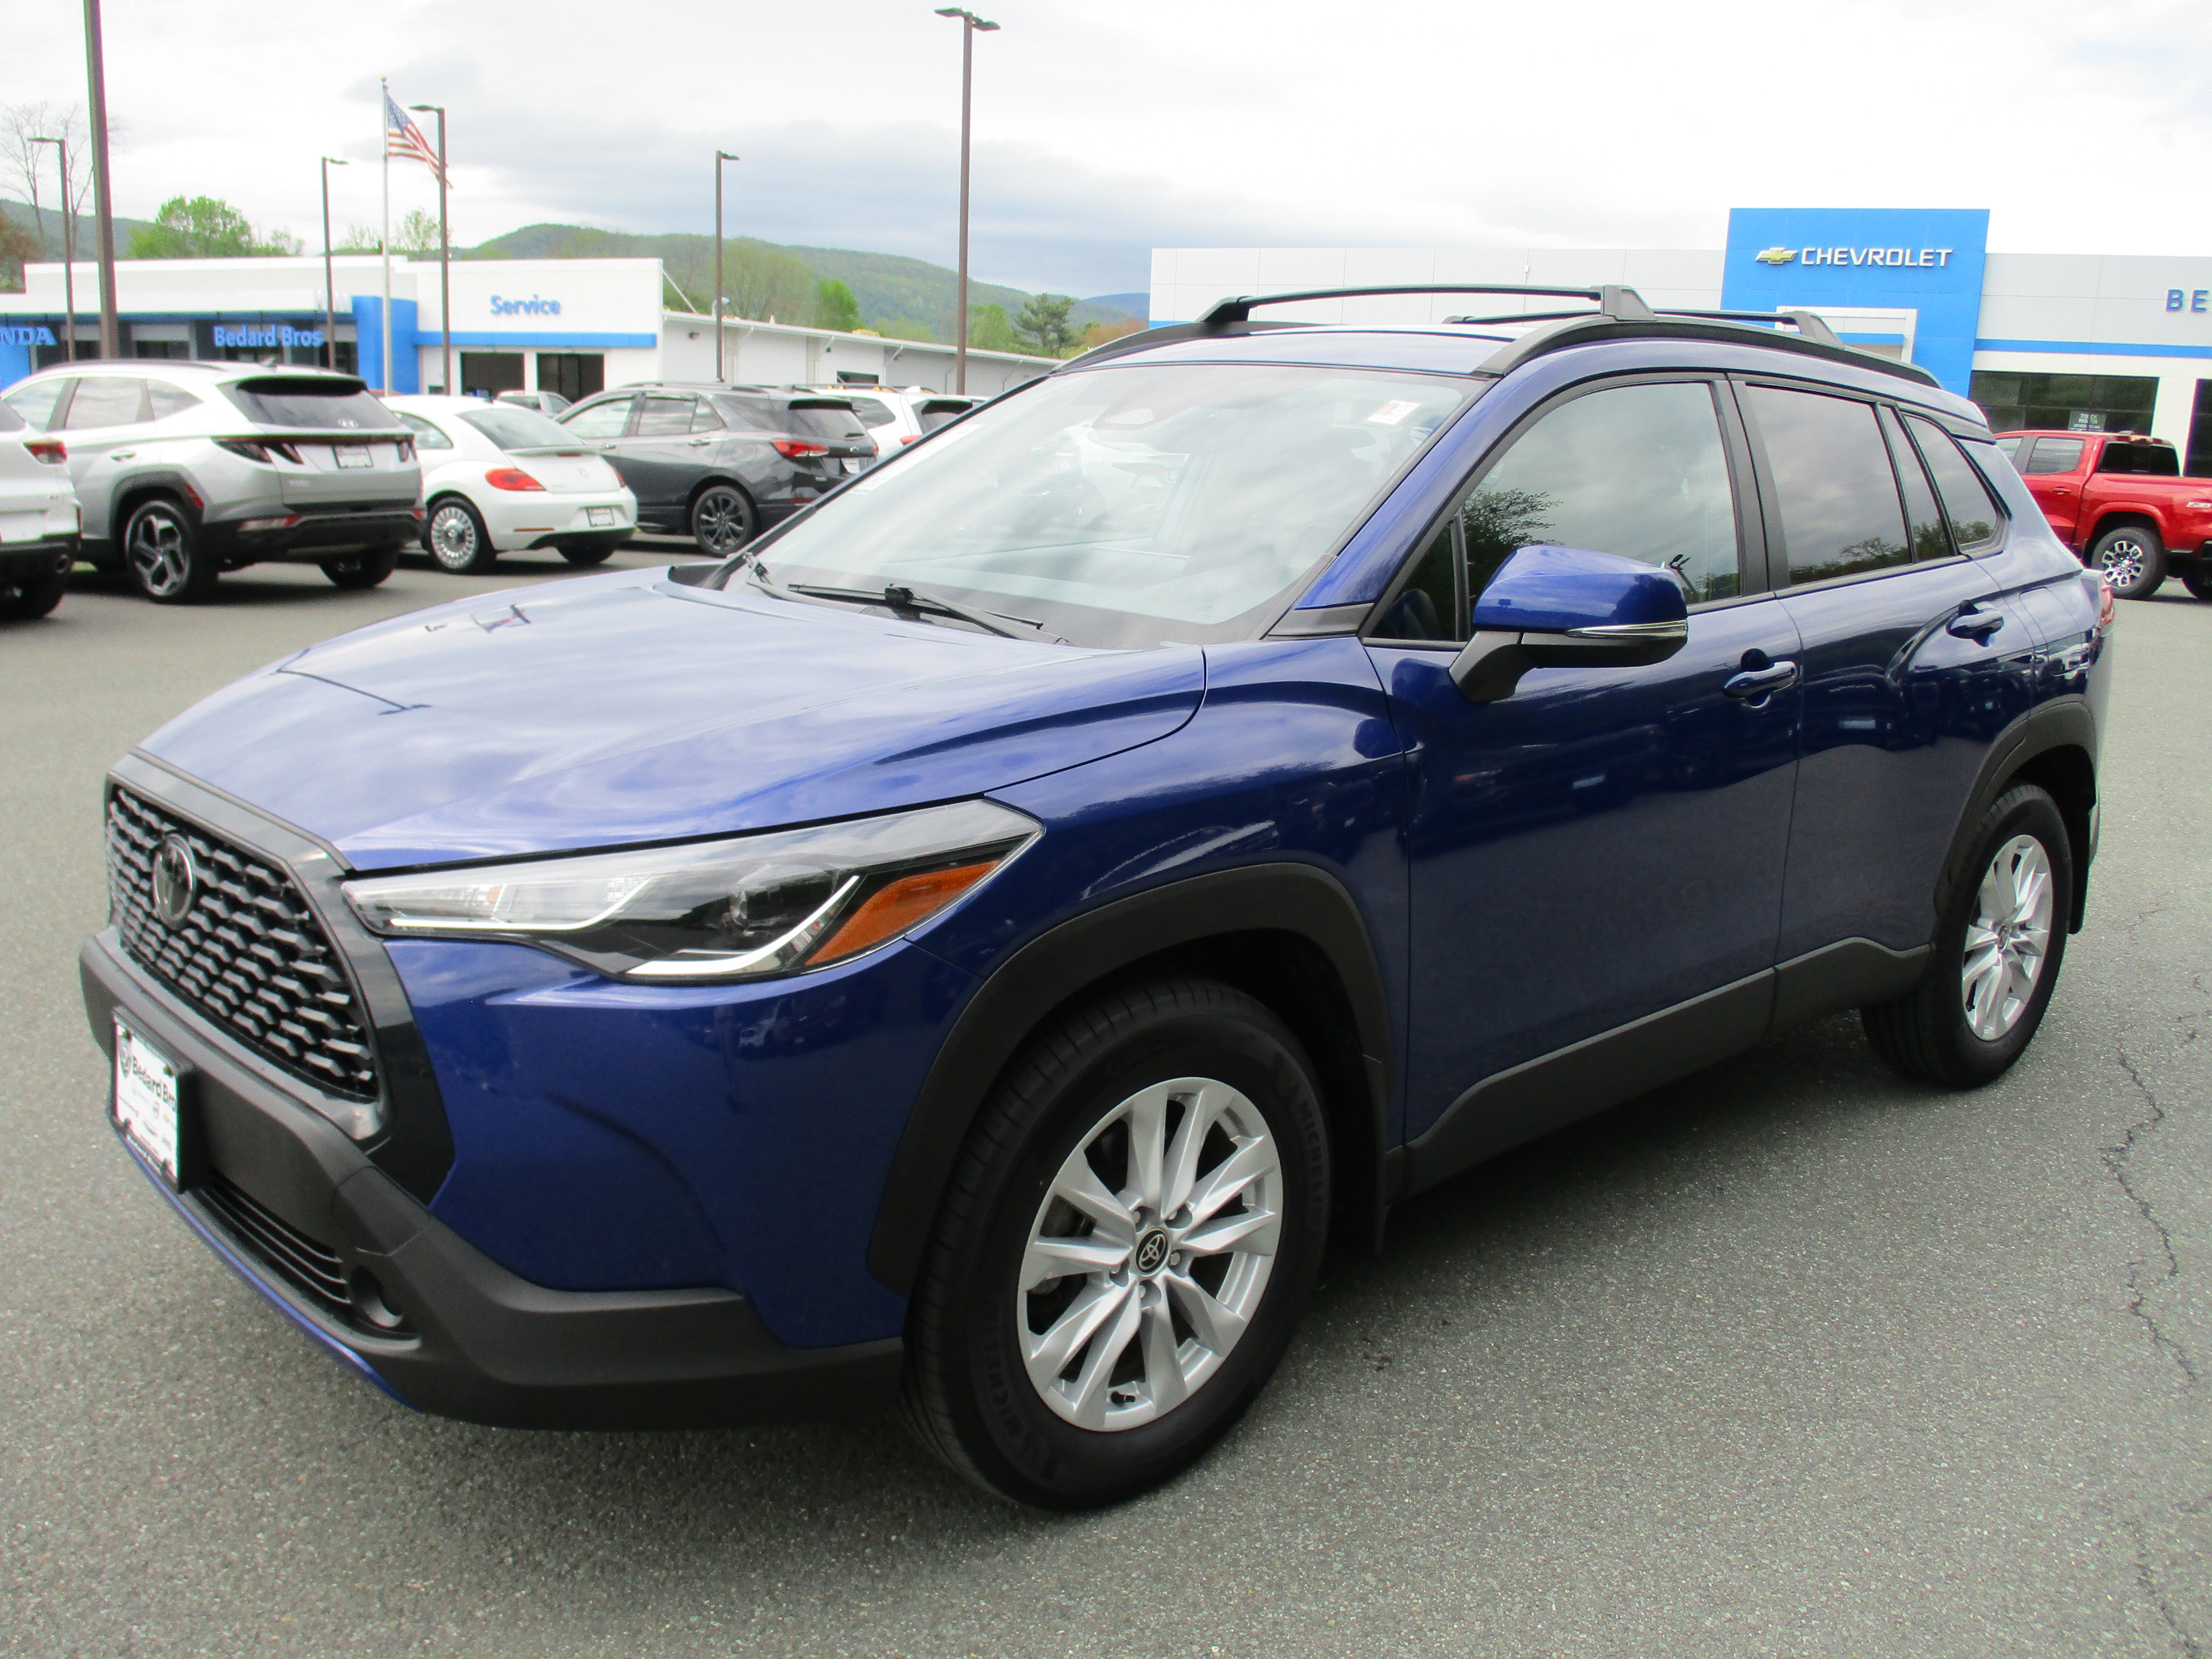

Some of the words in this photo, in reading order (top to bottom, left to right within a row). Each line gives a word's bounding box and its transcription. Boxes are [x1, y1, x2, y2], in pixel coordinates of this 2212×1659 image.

[1801, 247, 1954, 267] CHEVROLET
[490, 294, 562, 315] Service
[2166, 289, 2209, 313] BE
[214, 324, 277, 347] Bedard
[281, 325, 325, 347] Bros
